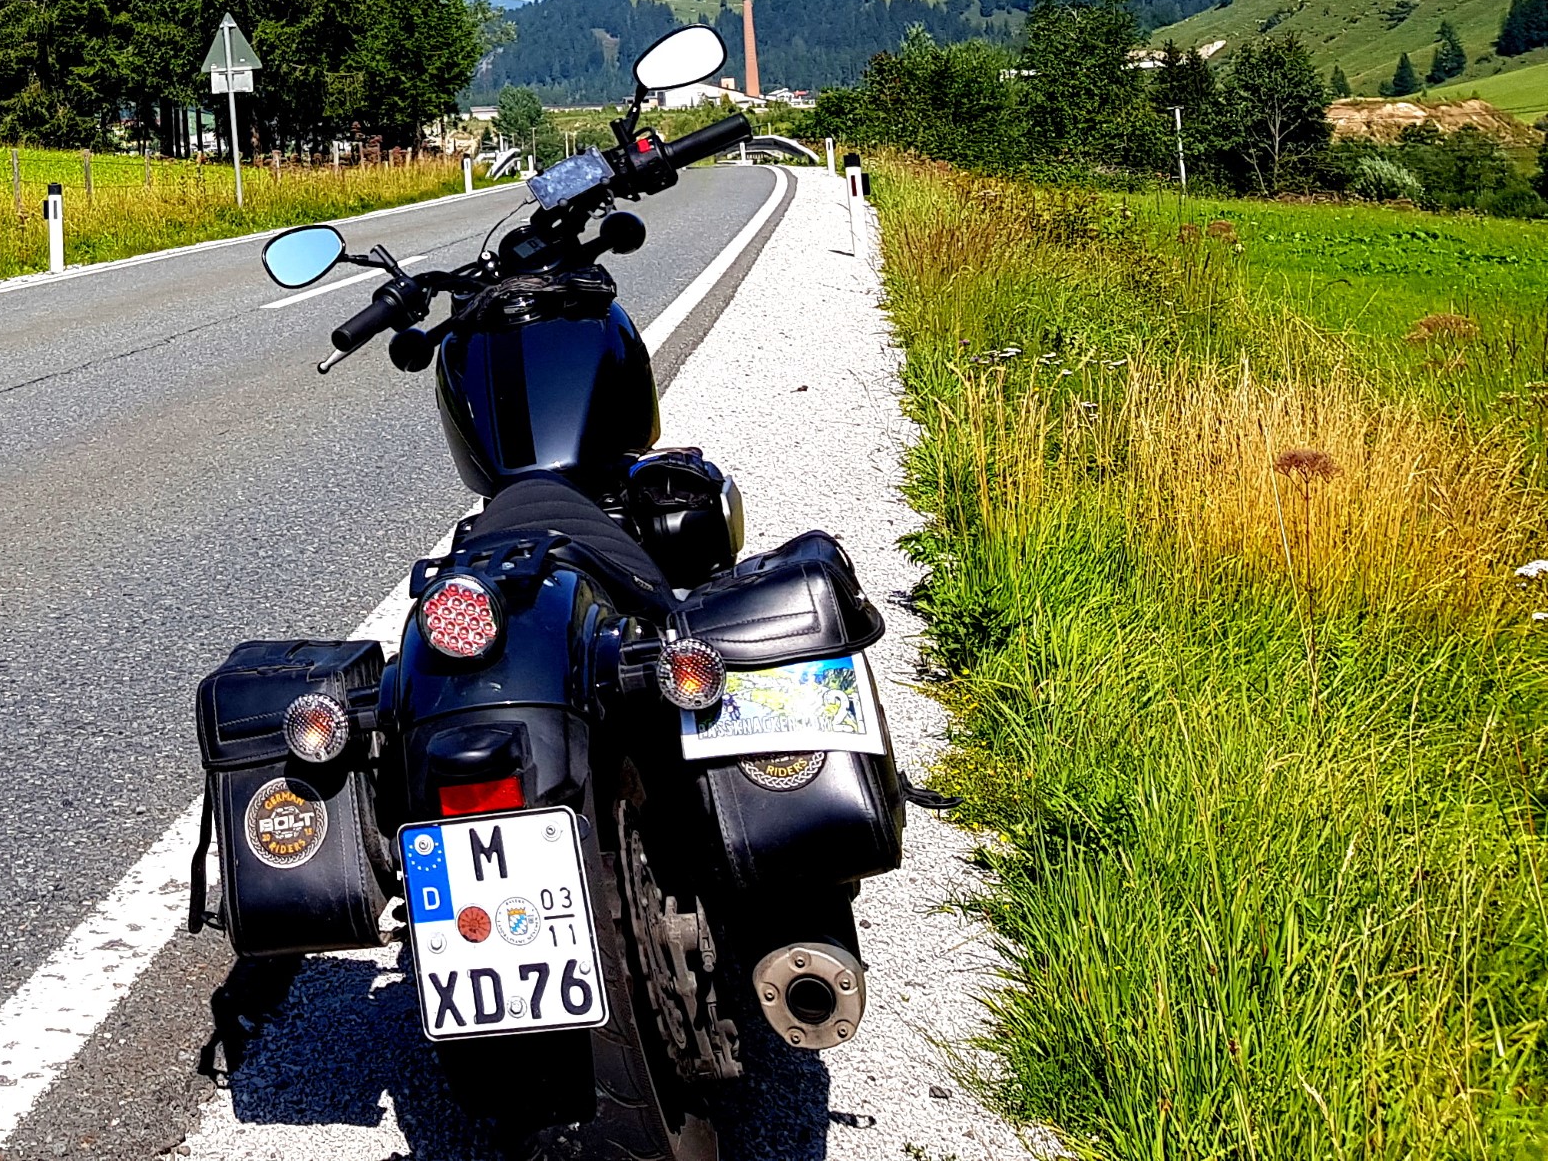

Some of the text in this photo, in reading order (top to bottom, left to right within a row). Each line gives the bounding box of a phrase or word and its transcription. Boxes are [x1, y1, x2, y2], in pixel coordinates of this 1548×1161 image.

[766, 757, 808, 777] RIDERS
[264, 791, 306, 810] GERMAN
[259, 812, 315, 833] BOLT
[269, 838, 306, 854] RIDERS
[469, 825, 508, 881] M
[422, 887, 441, 910] D
[541, 887, 573, 911] 03
[548, 924, 577, 947] 11
